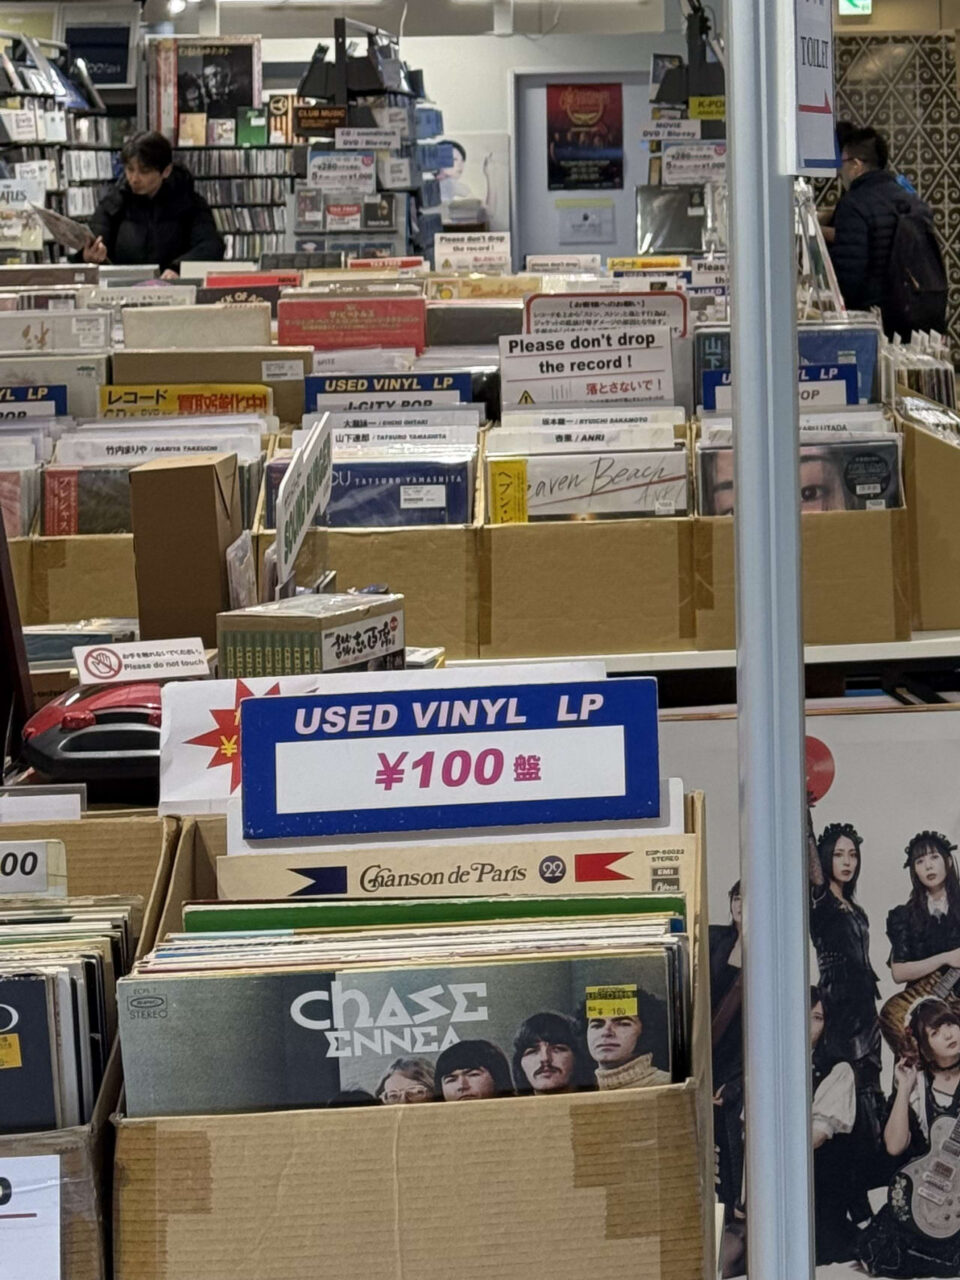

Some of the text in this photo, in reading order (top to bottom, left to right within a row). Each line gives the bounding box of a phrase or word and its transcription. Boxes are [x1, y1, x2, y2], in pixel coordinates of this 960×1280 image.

[800, 36, 829, 70] TOILET
[440, 234, 505, 244] Please don't drop
[697, 263, 726, 271] Pleas
[508, 332, 656, 354] Please don't drop
[705, 336, 722, 370] 山下
[539, 360, 565, 374] the
[569, 356, 622, 371] record
[819, 367, 838, 380] LP
[325, 377, 454, 391] USED VINYL LP
[27, 387, 49, 400] LP
[107, 389, 169, 405] レコード
[579, 417, 608, 425] RYUICHI
[609, 416, 648, 424] SAKAMOTO
[335, 433, 369, 443] 山下達郎
[581, 434, 605, 442] ANRI
[106, 445, 147, 456] 竹内まりや
[355, 475, 462, 486] TATSURO YAMASHITA
[589, 456, 673, 498] Beach
[123, 657, 205, 671] Please do not touch
[294, 693, 605, 736] USED VINYL LP
[375, 747, 543, 792] ¥100 盤
[651, 854, 680, 863] STEREO
[359, 860, 563, 893] Chanson de Paris 22
[656, 867, 675, 876] EMI
[129, 1009, 168, 1020] STEREO
